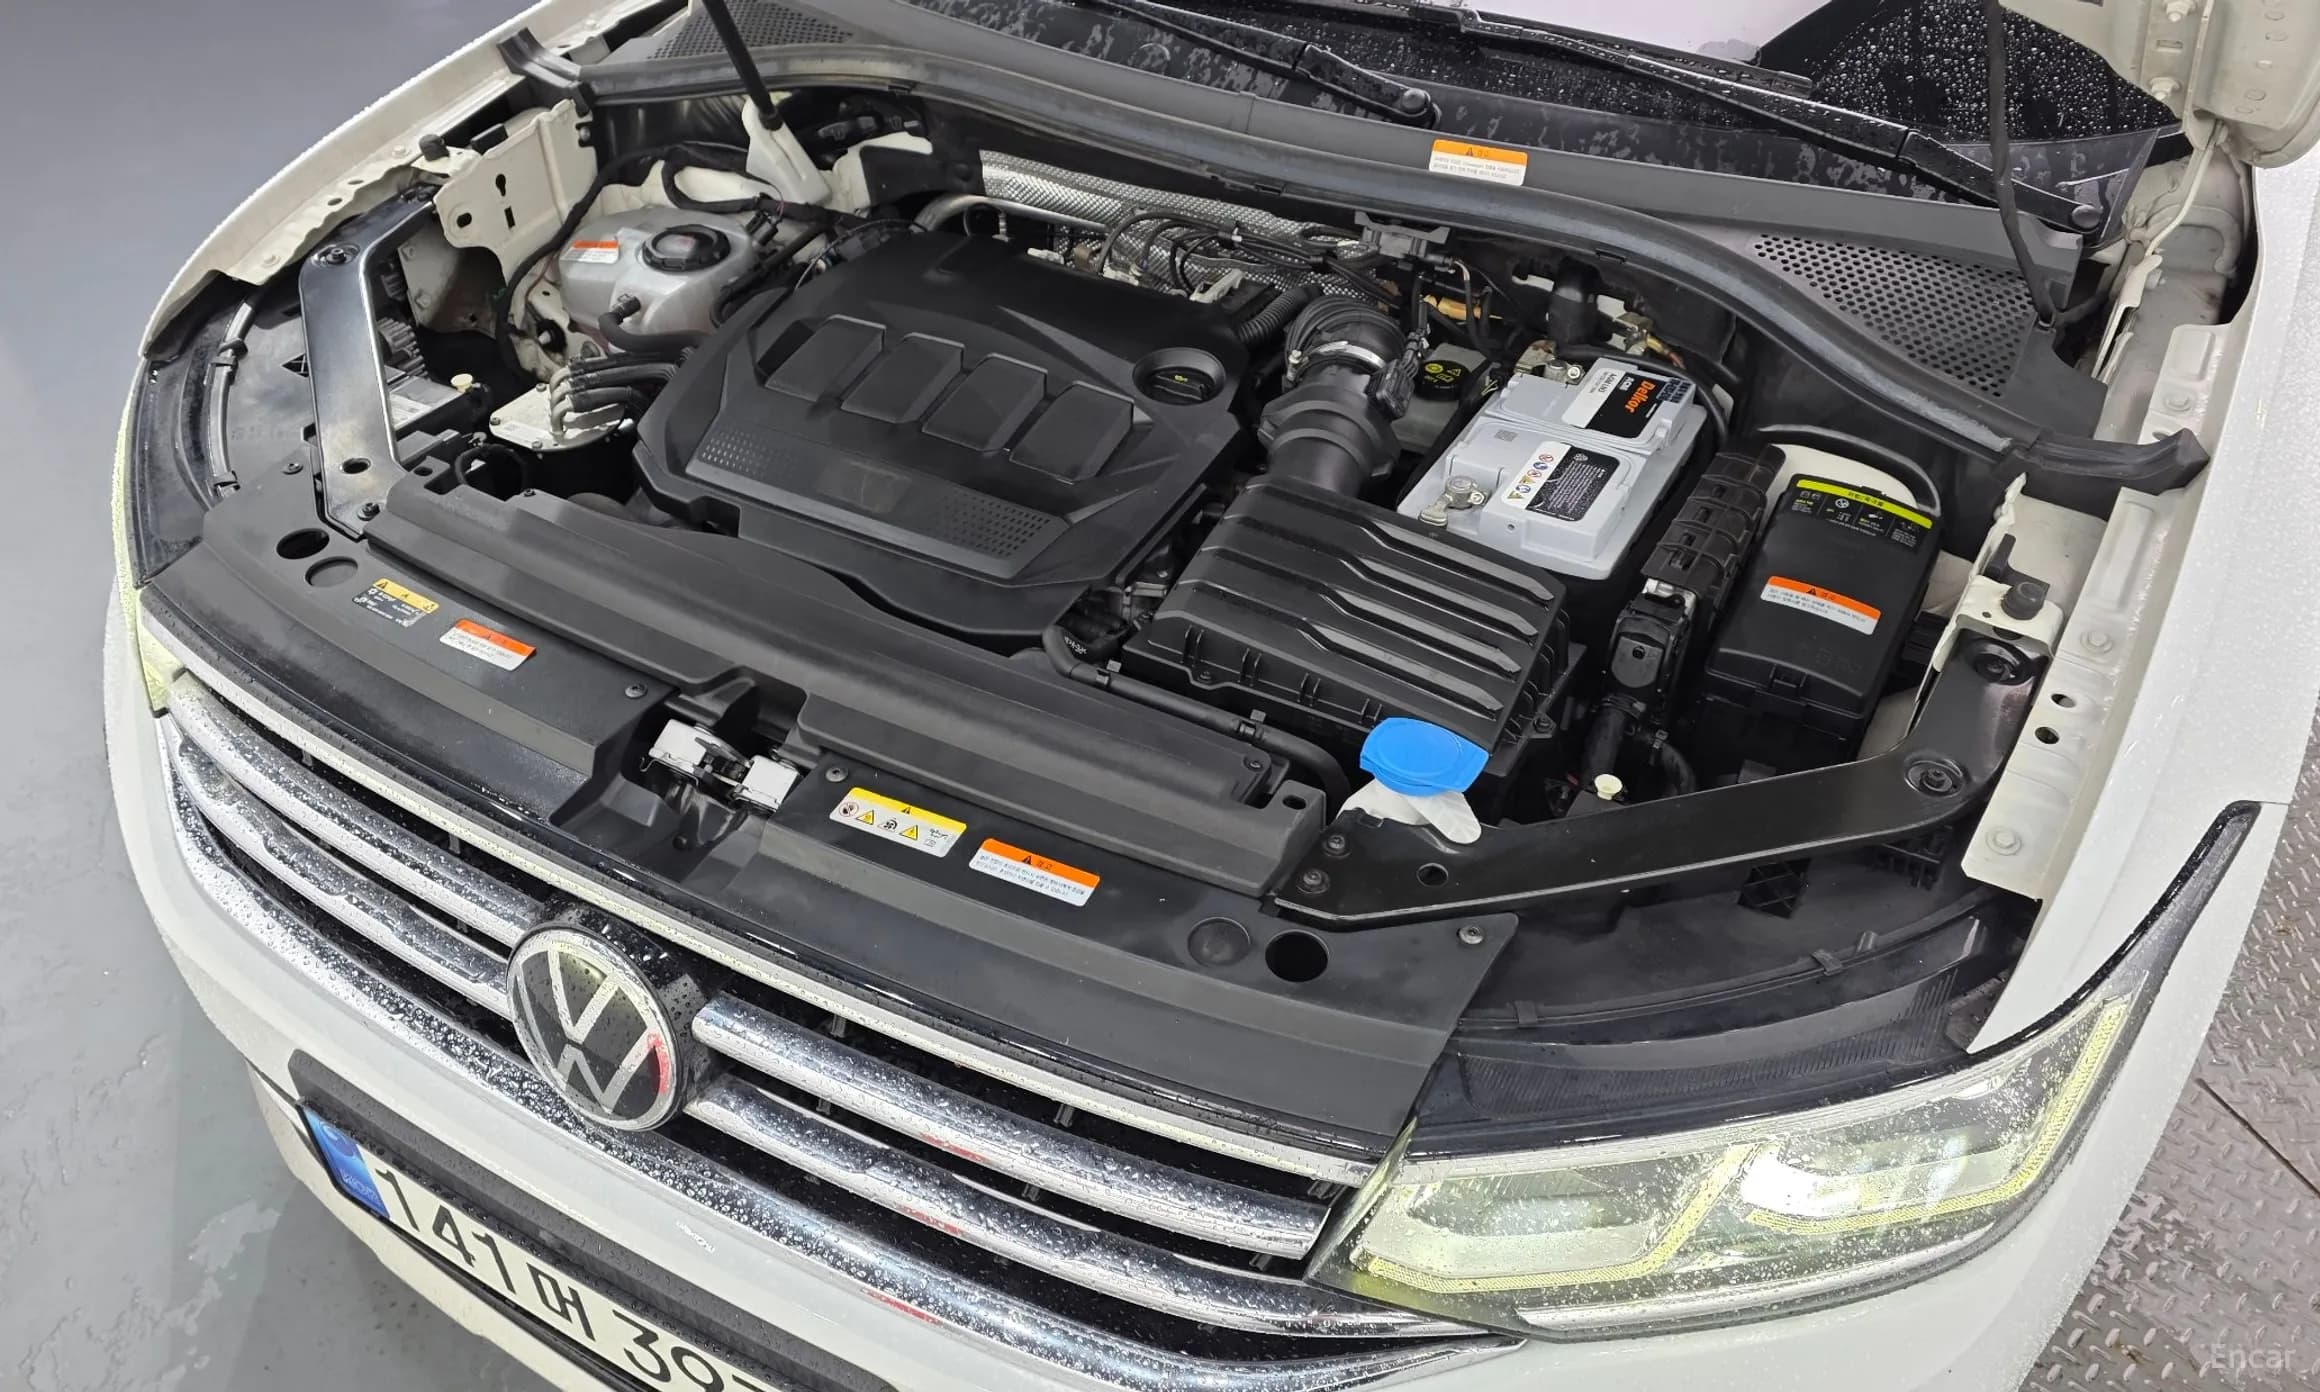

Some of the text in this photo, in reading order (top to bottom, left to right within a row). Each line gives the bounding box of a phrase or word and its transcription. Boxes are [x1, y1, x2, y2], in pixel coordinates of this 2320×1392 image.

[1624, 379, 1657, 414] Delkor
[375, 1168, 766, 1392] 141머 39
